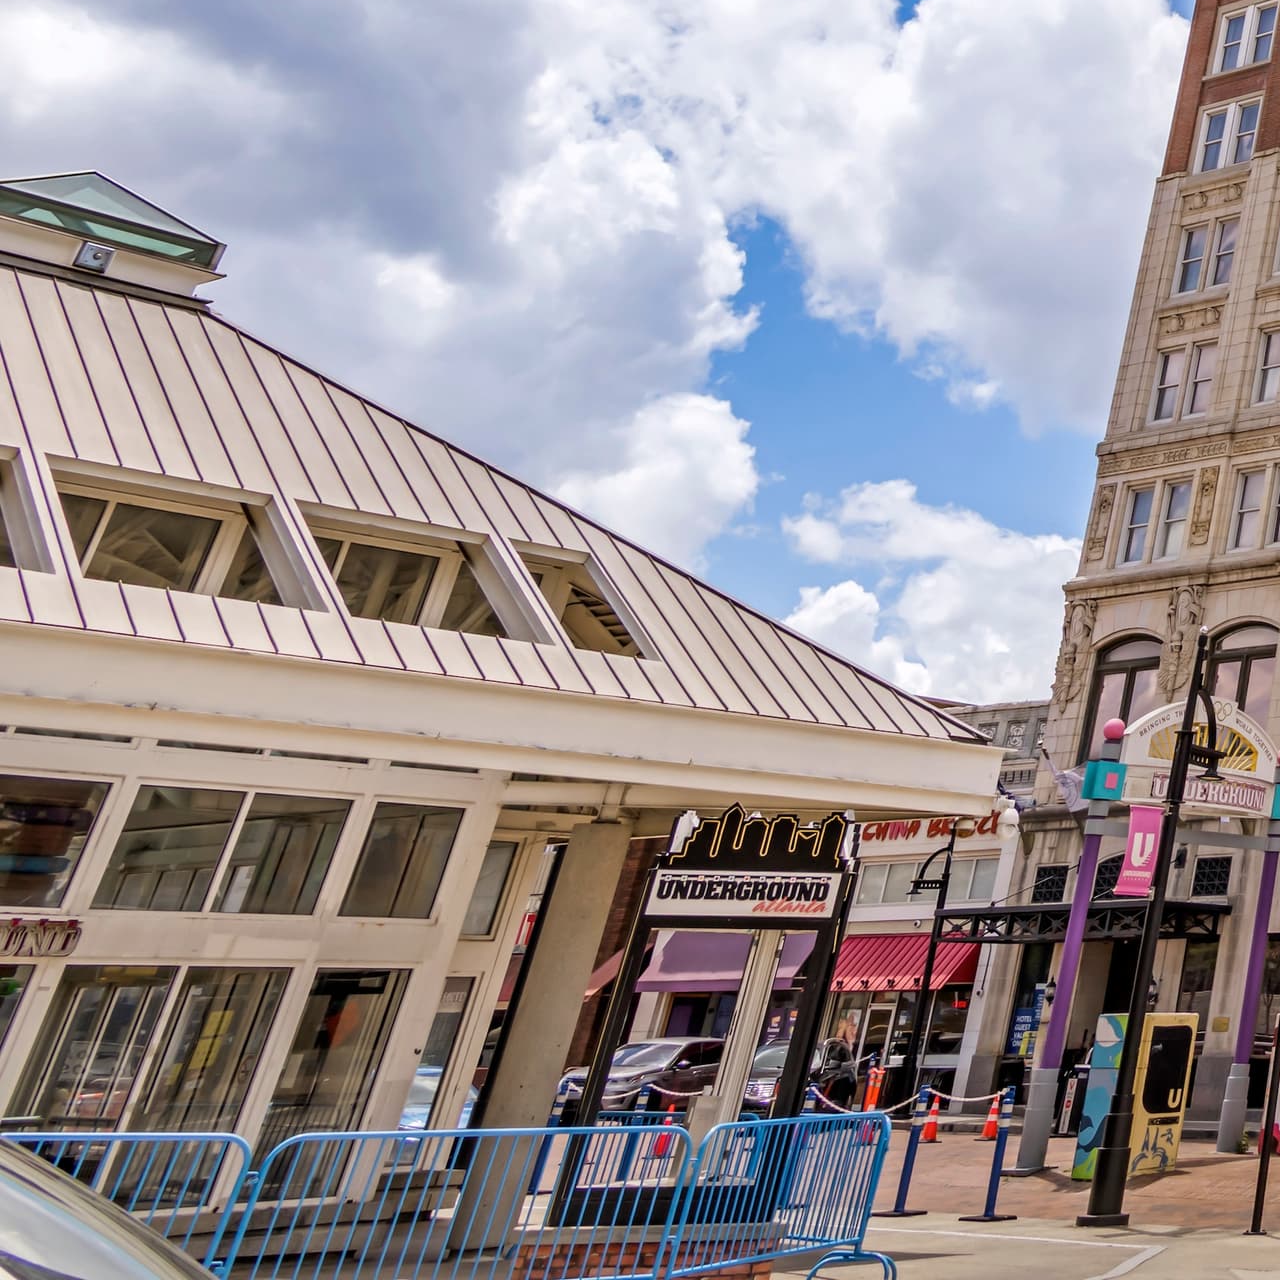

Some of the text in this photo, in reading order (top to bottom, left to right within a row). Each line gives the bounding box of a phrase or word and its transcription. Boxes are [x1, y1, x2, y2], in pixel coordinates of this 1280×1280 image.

[1152, 776, 1265, 810] UDERGROUND
[862, 820, 921, 842] CHINA
[1131, 832, 1155, 867] U
[657, 879, 830, 902] UNDERGROUND
[752, 896, 827, 913] atlanta
[1167, 1088, 1181, 1108] U
